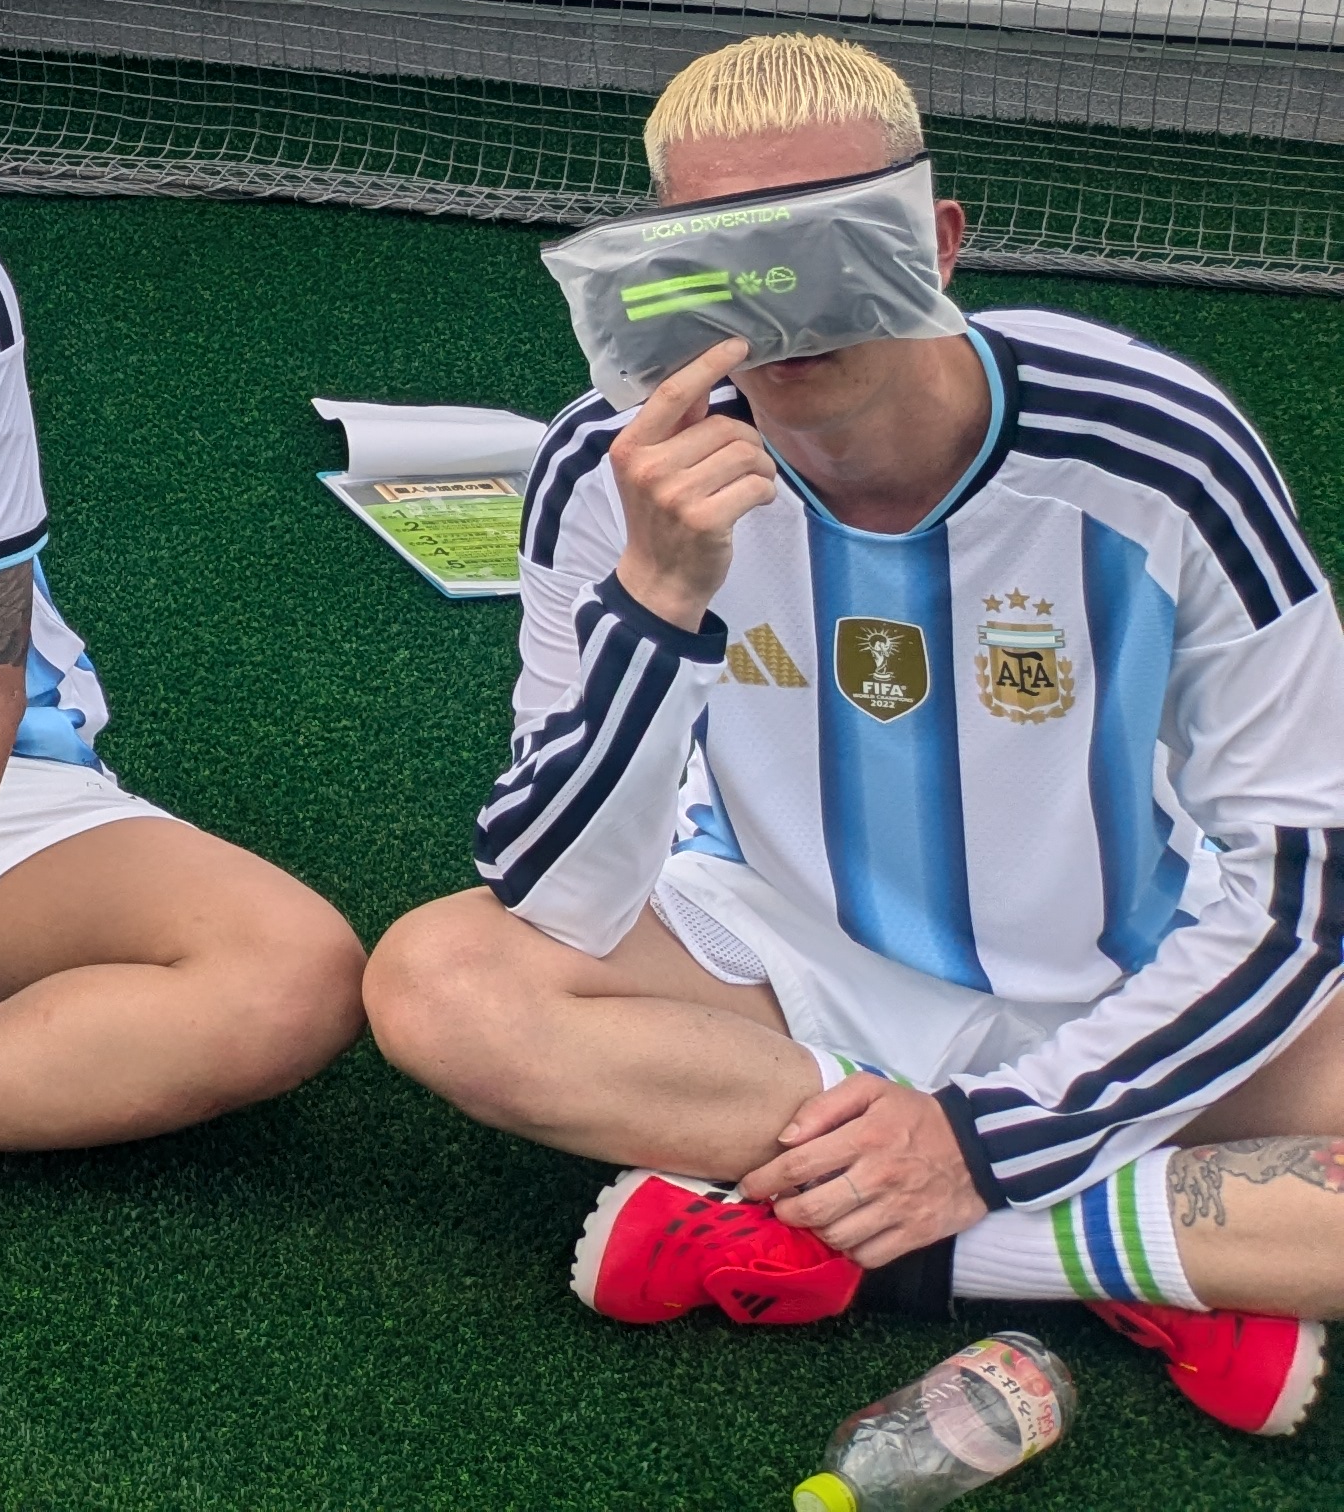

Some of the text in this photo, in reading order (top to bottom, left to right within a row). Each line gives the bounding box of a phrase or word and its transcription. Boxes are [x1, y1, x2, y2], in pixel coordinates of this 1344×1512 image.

[419, 536, 438, 546] 3
[434, 547, 450, 556] 4
[446, 560, 465, 569] 5
[995, 649, 1055, 697] AFA
[862, 681, 903, 697] FIFA
[871, 699, 895, 709] 2022
